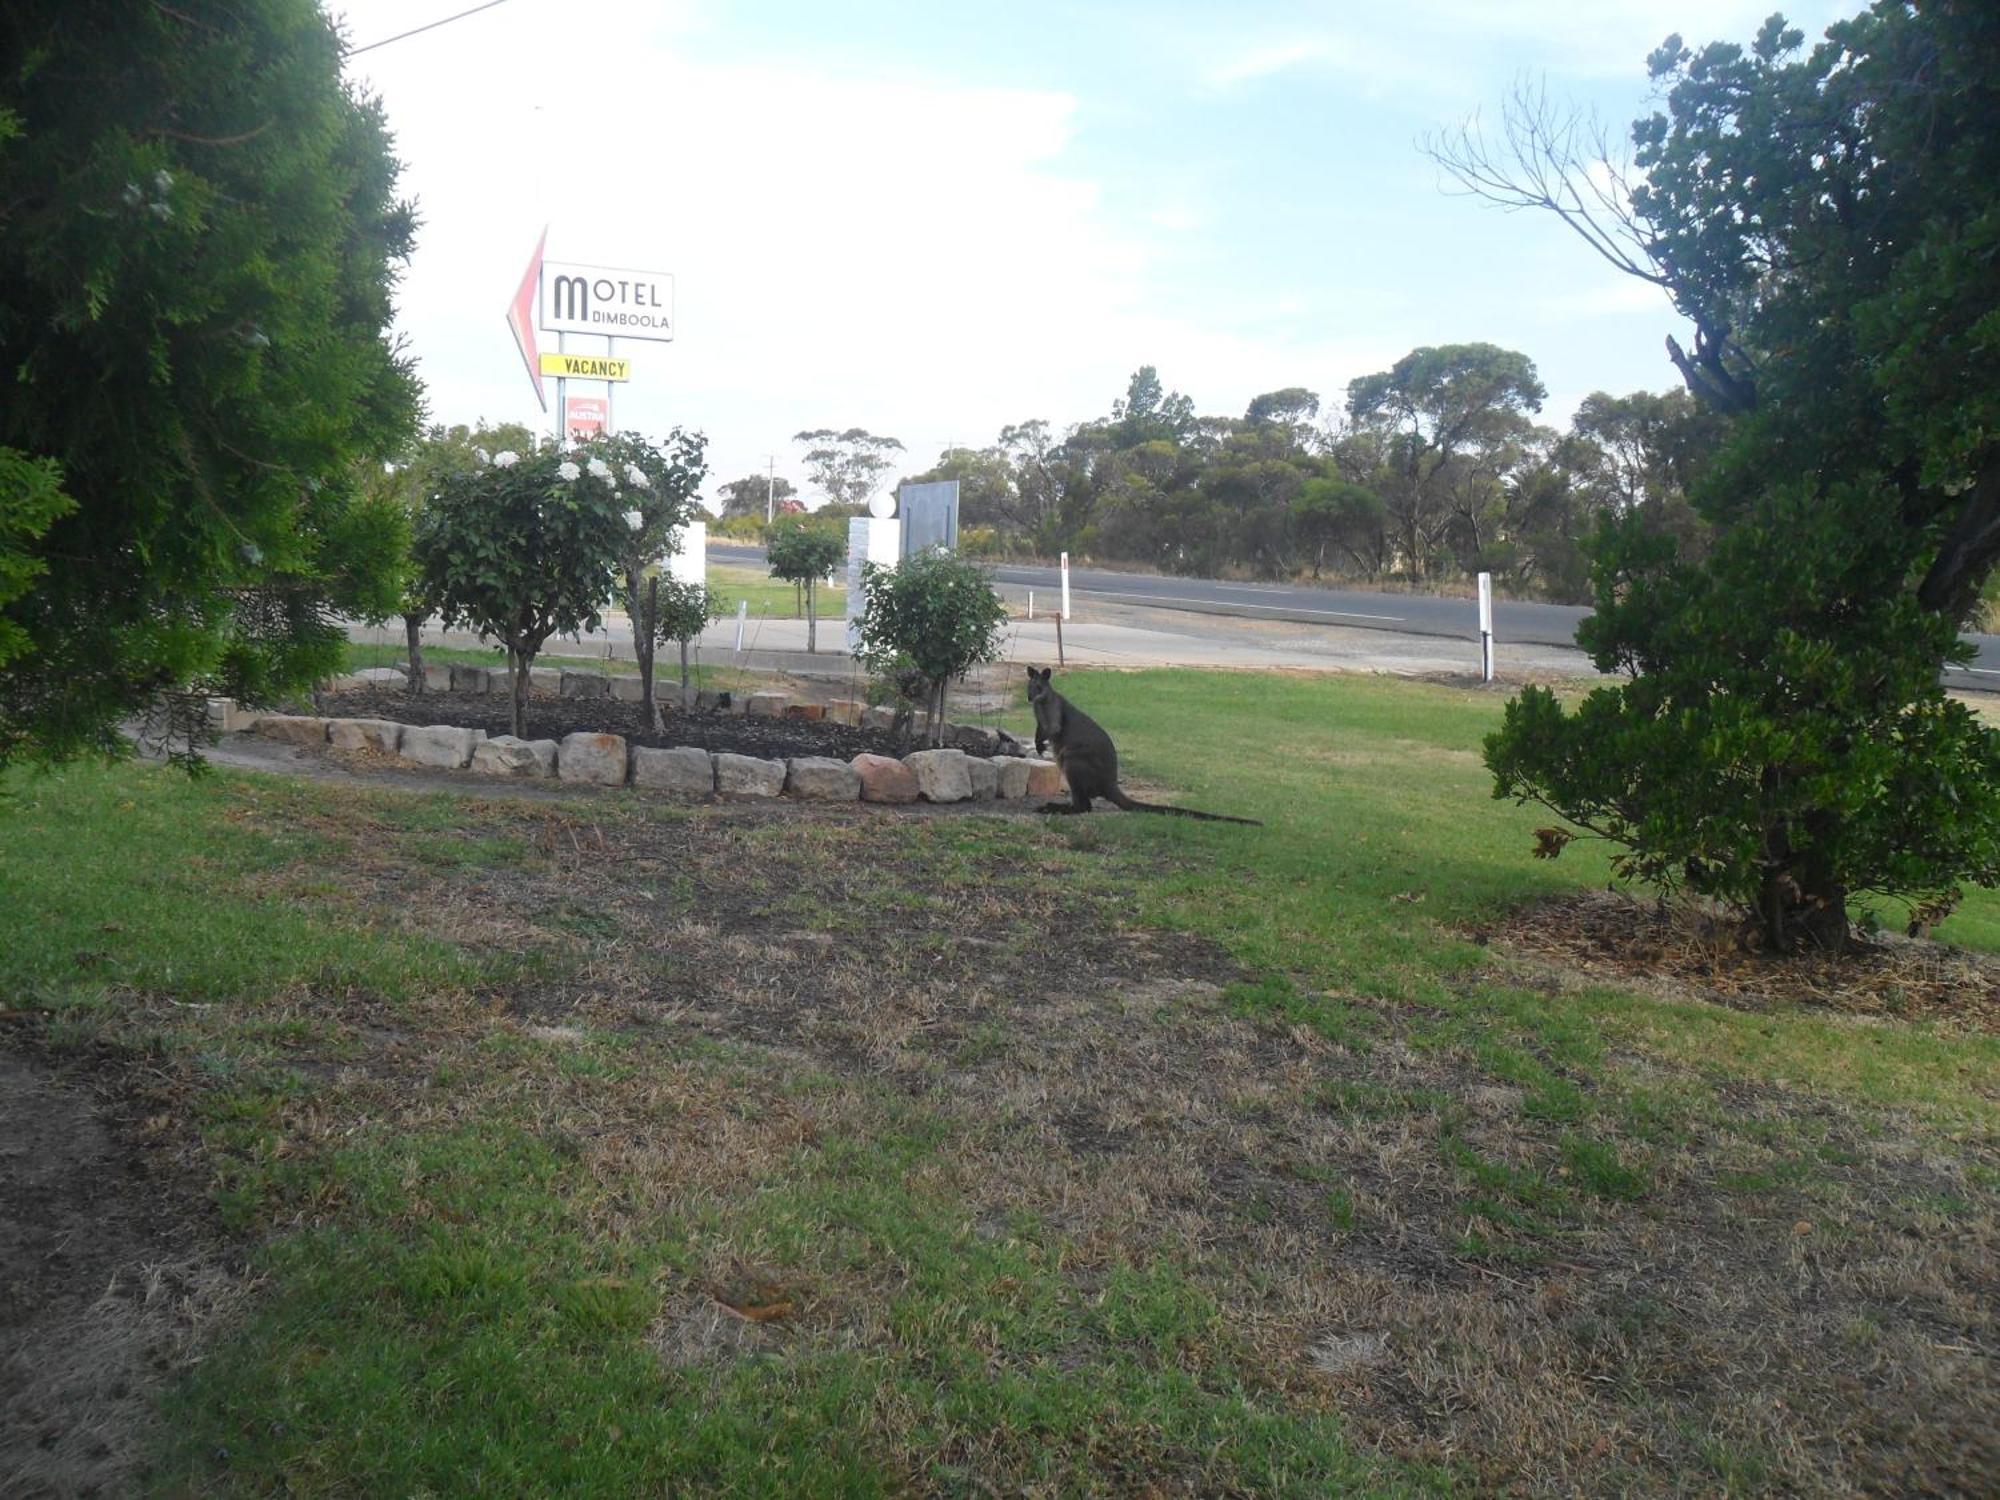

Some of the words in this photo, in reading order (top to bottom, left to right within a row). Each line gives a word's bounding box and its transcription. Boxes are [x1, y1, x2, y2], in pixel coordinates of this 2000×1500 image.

[554, 275, 662, 321] MOTEL
[593, 311, 669, 329] DIMBOOLA
[565, 359, 625, 377] VACANCY
